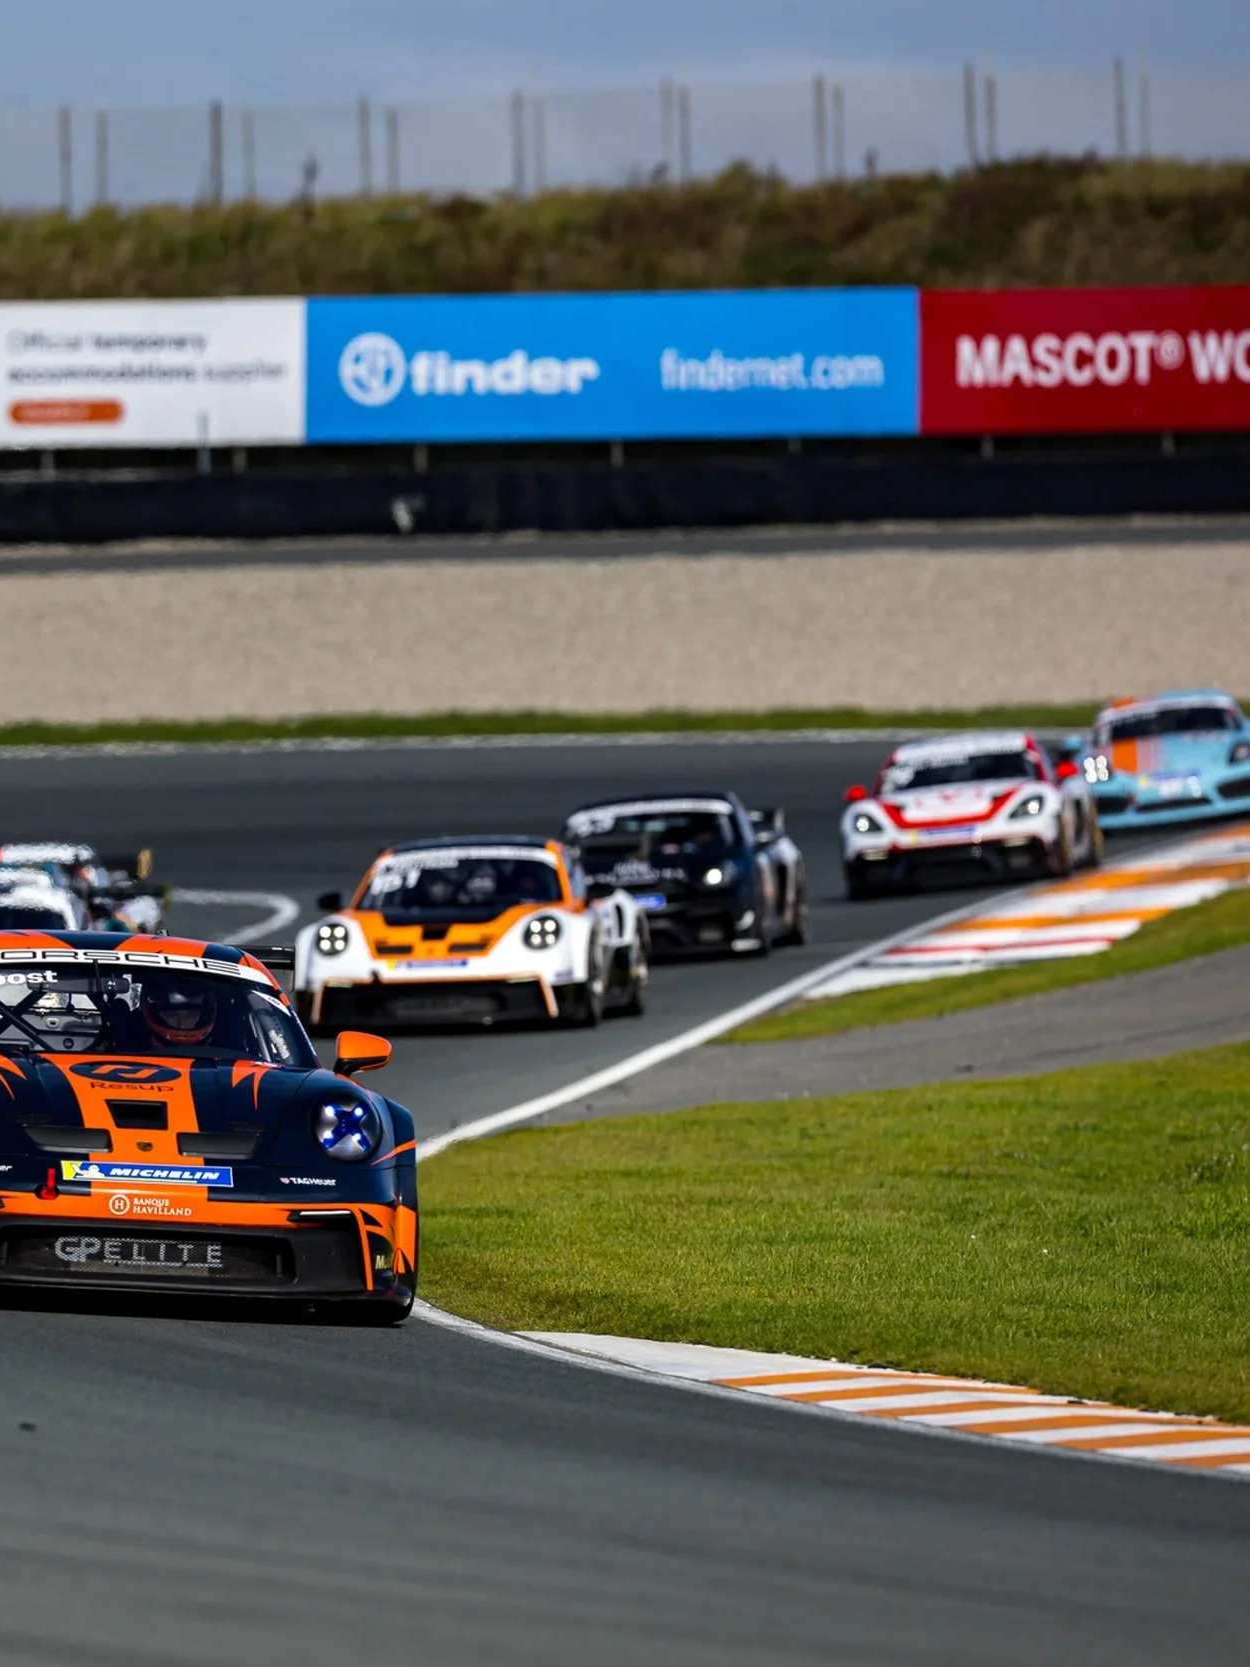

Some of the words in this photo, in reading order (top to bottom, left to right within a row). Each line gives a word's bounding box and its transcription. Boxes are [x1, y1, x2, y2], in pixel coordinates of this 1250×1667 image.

[410, 348, 600, 396] finder
[660, 347, 884, 390] findernet.com
[90, 1082, 174, 1092] Resup
[110, 1167, 220, 1181] MICHELIN
[133, 1197, 170, 1208] BANQUE
[133, 1206, 192, 1216] HAVILLAND
